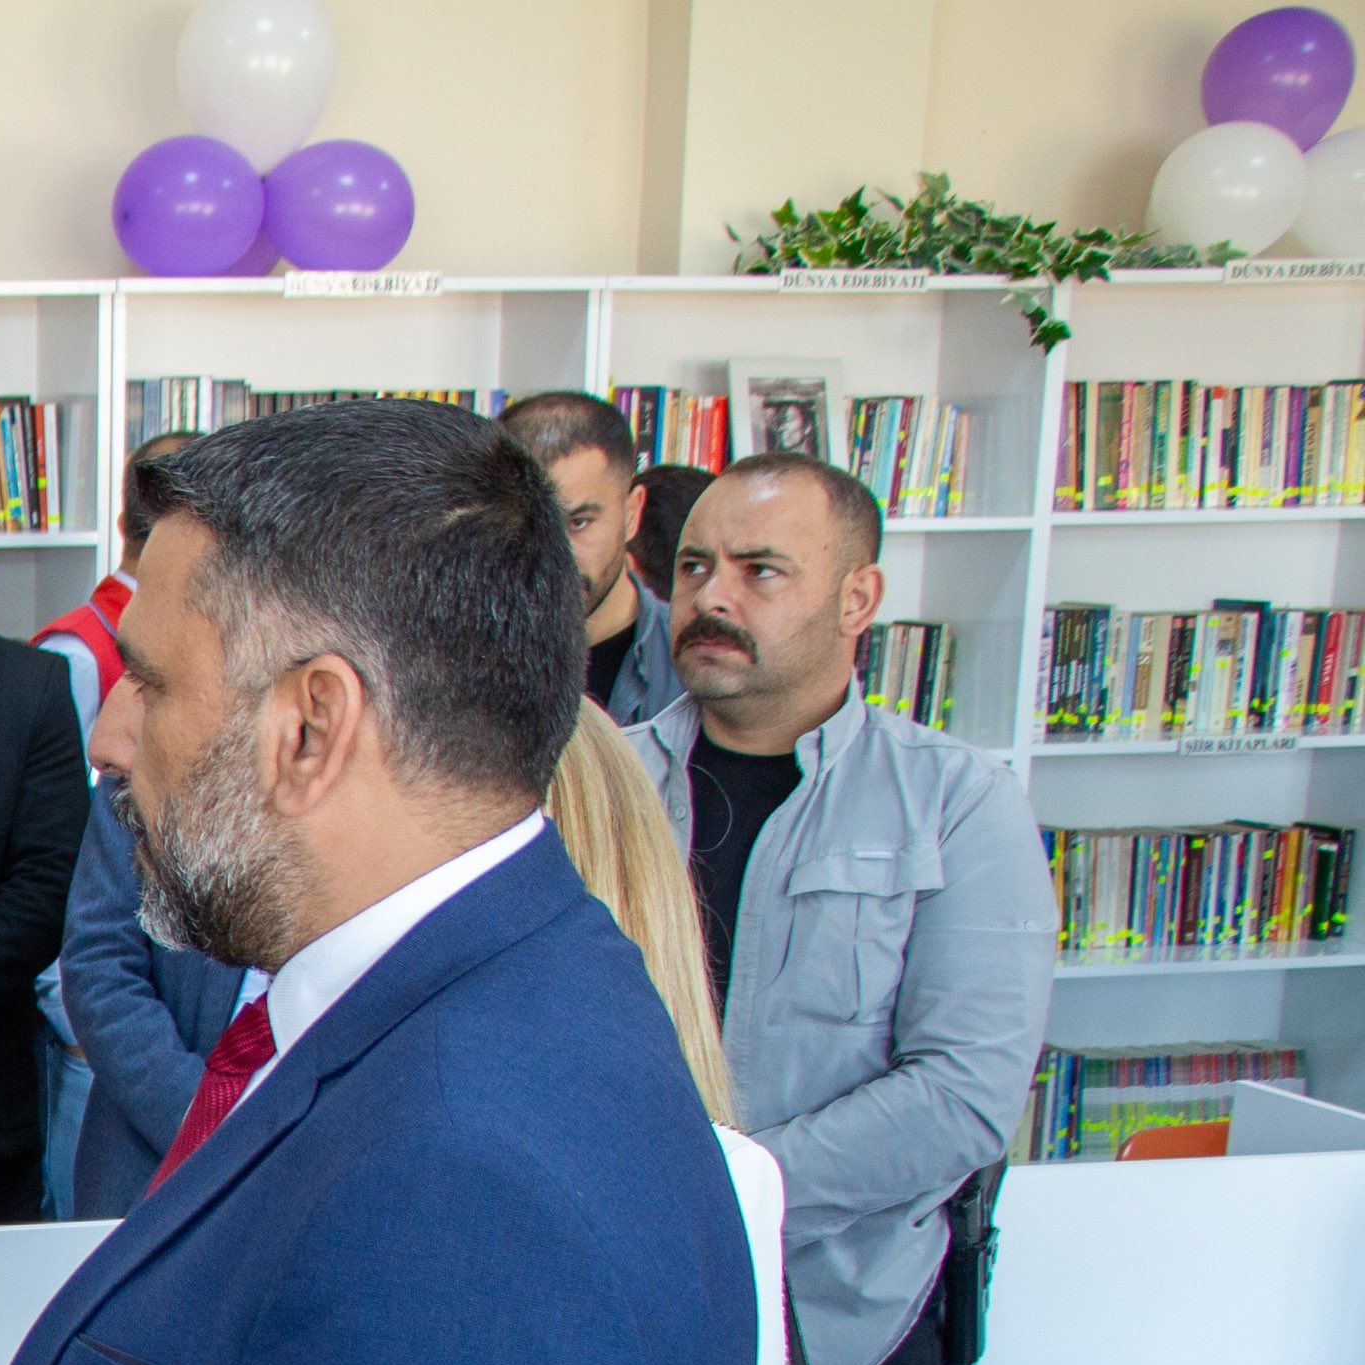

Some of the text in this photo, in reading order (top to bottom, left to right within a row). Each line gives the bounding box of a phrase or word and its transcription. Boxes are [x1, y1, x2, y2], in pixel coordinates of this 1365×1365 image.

[1288, 259, 1365, 277] EDEBİYAT
[782, 271, 926, 288] DÜNYA EDEBİYATI
